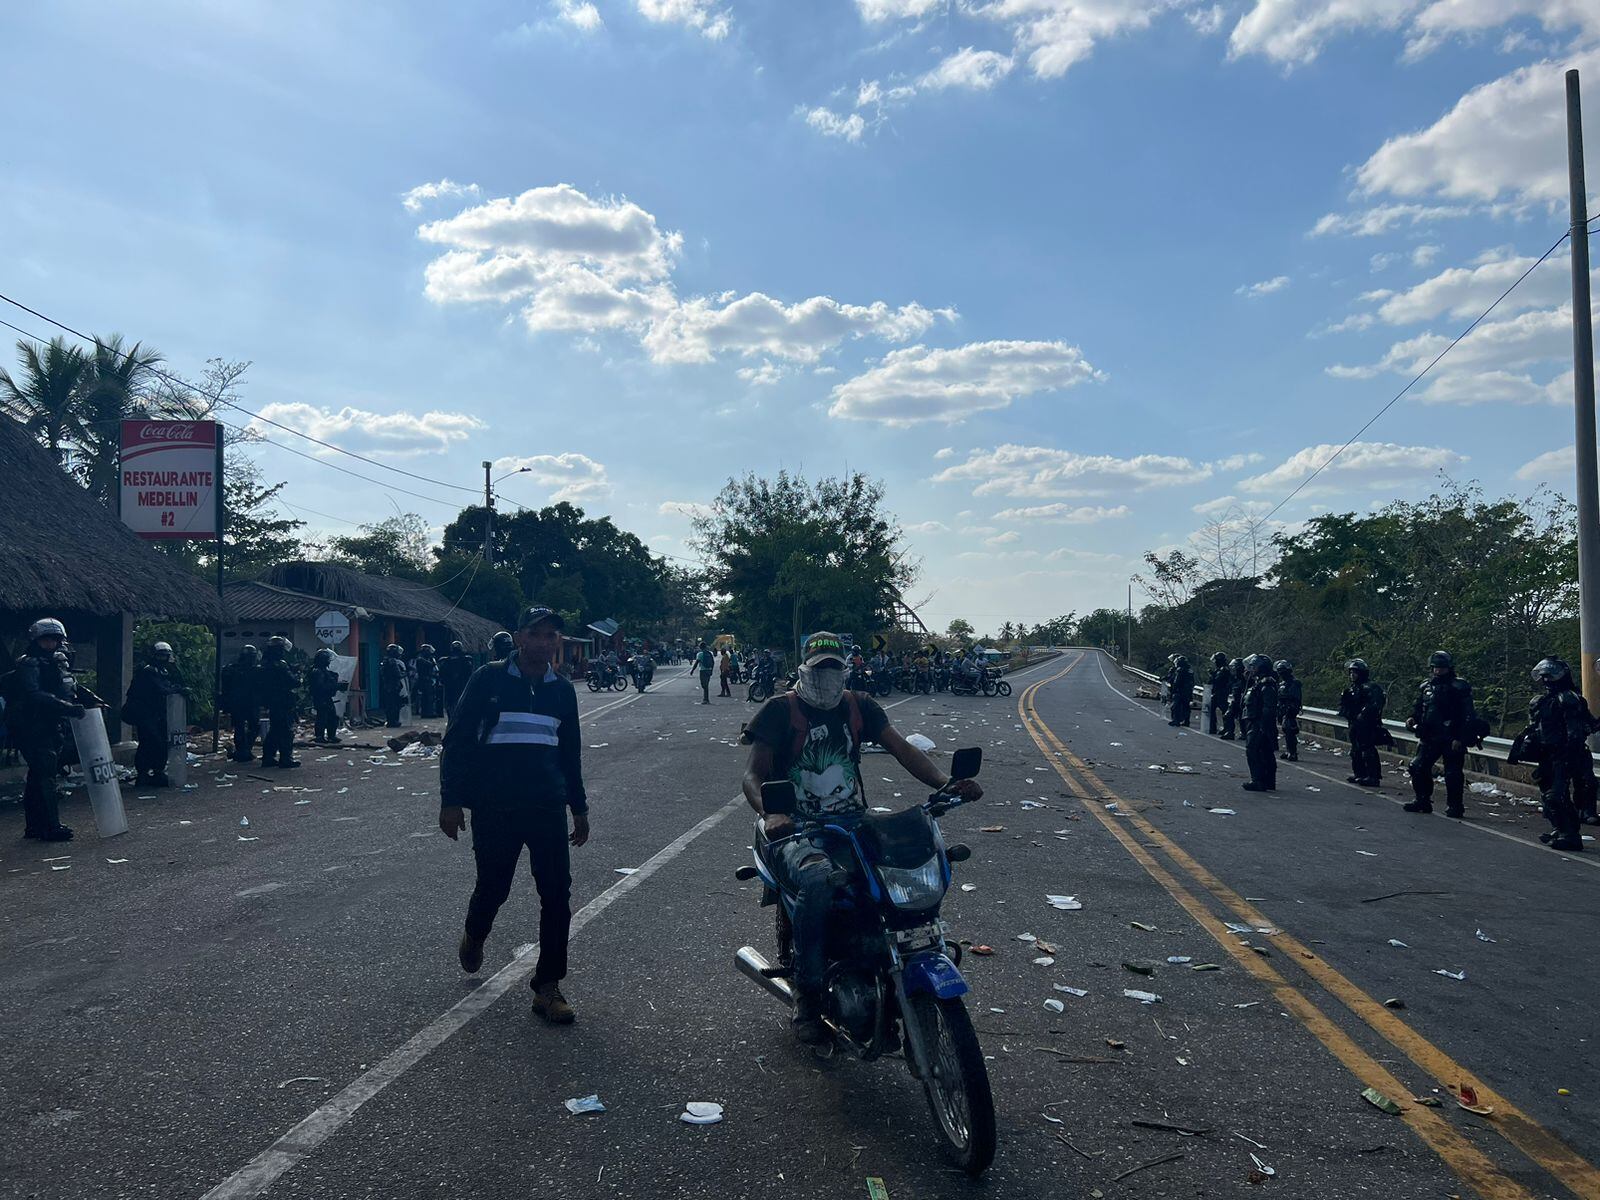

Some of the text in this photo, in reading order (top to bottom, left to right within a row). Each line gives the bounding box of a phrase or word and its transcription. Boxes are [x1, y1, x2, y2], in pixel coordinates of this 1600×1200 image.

[140, 424, 195, 439] Coca-Cola
[123, 471, 213, 486] RESTAURANTE
[138, 491, 198, 506] MEDELLIN
[161, 511, 175, 527] #2
